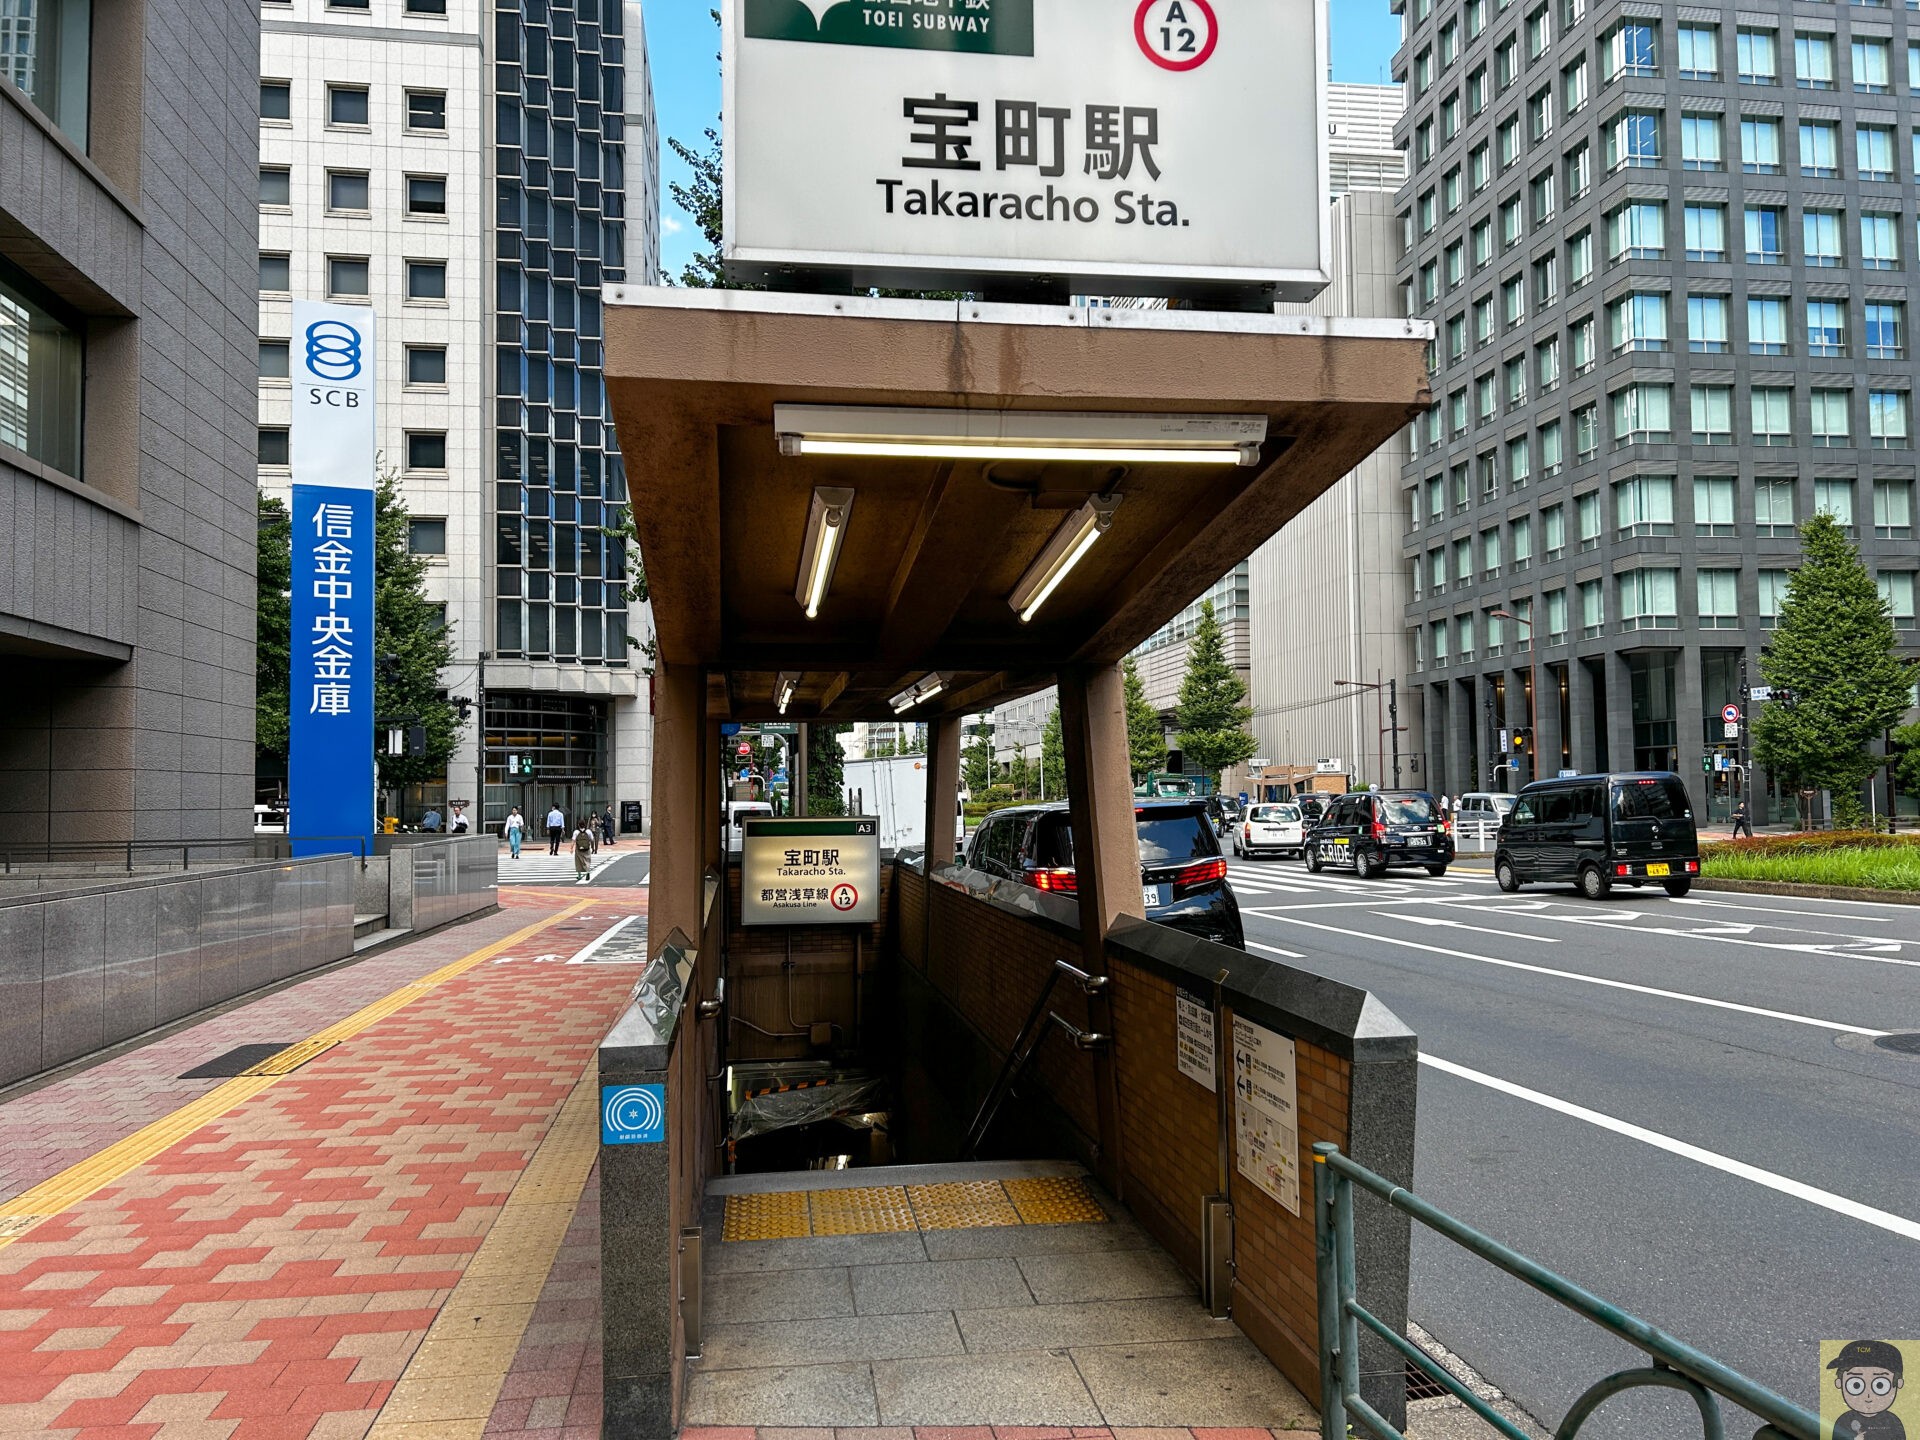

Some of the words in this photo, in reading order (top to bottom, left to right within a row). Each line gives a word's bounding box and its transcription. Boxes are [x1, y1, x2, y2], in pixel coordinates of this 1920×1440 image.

[862, 9, 903, 28] TOEI
[912, 12, 990, 33] SUBWAY
[1165, 0, 1187, 23] A
[1160, 27, 1196, 53] 12
[901, 93, 1162, 182] 宝町駅
[876, 179, 1099, 223] Takaracho
[1113, 188, 1191, 227] Sta.
[309, 387, 360, 408] SCB
[310, 502, 354, 717] 信金中央金庫
[857, 824, 872, 833] A3
[783, 849, 840, 867] 宝町駅
[776, 867, 826, 877] Takaracho
[828, 866, 846, 876] Sta.
[760, 887, 829, 902] 都営浅草線
[838, 896, 851, 905] 12
[840, 887, 849, 896] A
[772, 901, 802, 909] Asakusa
[802, 900, 818, 908] Line
